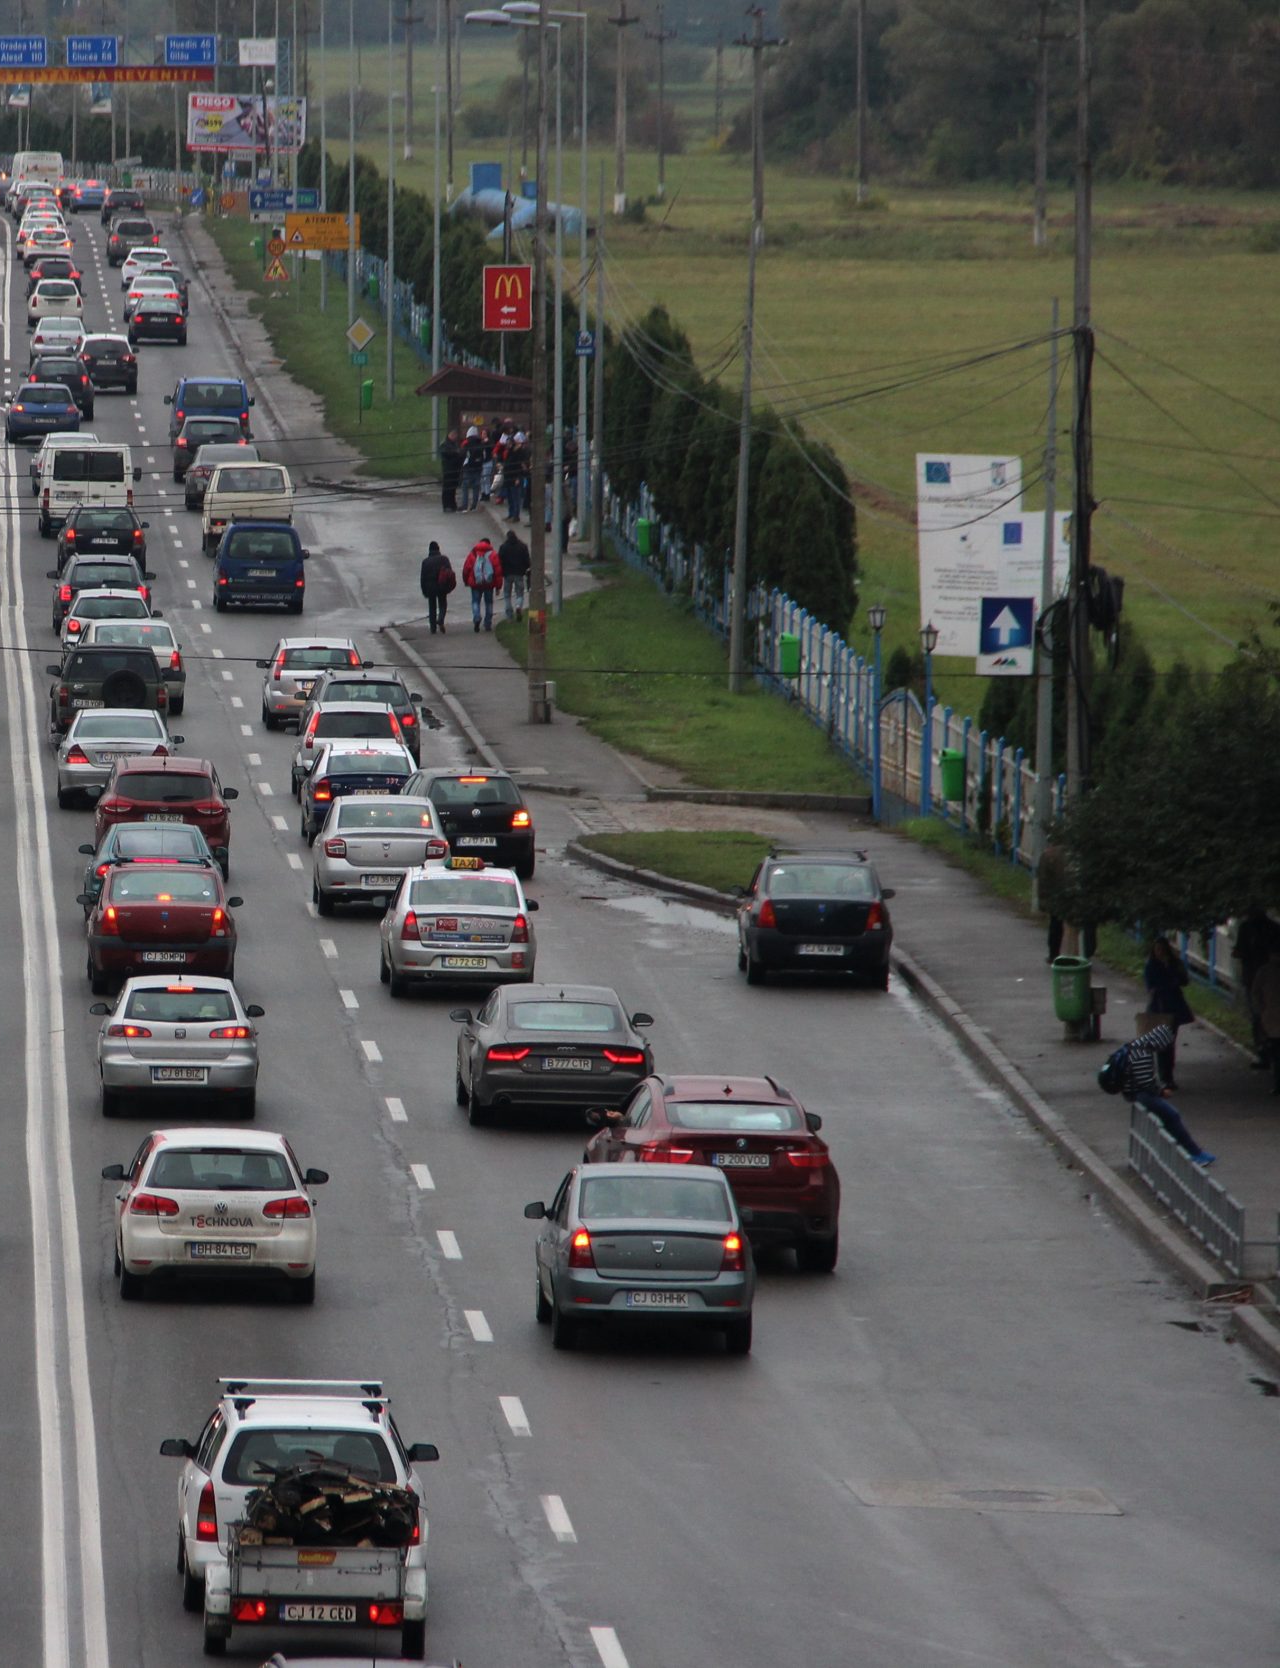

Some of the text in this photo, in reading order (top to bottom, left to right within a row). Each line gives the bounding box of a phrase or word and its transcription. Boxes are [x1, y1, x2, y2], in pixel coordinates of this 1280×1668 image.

[196, 97, 230, 107] DIEGO
[454, 858, 475, 868] TAXI
[146, 952, 157, 961] CJ
[448, 957, 458, 966] CJ
[460, 957, 469, 966] 72
[161, 1068, 201, 1078] CJ 81 BIZ
[729, 1155, 746, 1164] 200
[190, 1214, 254, 1229] TECHNOVA
[197, 1244, 249, 1255] BH 84 TEC
[633, 1292, 687, 1304] CJ 03 HHK
[287, 1606, 353, 1620] CJ 12 CED
